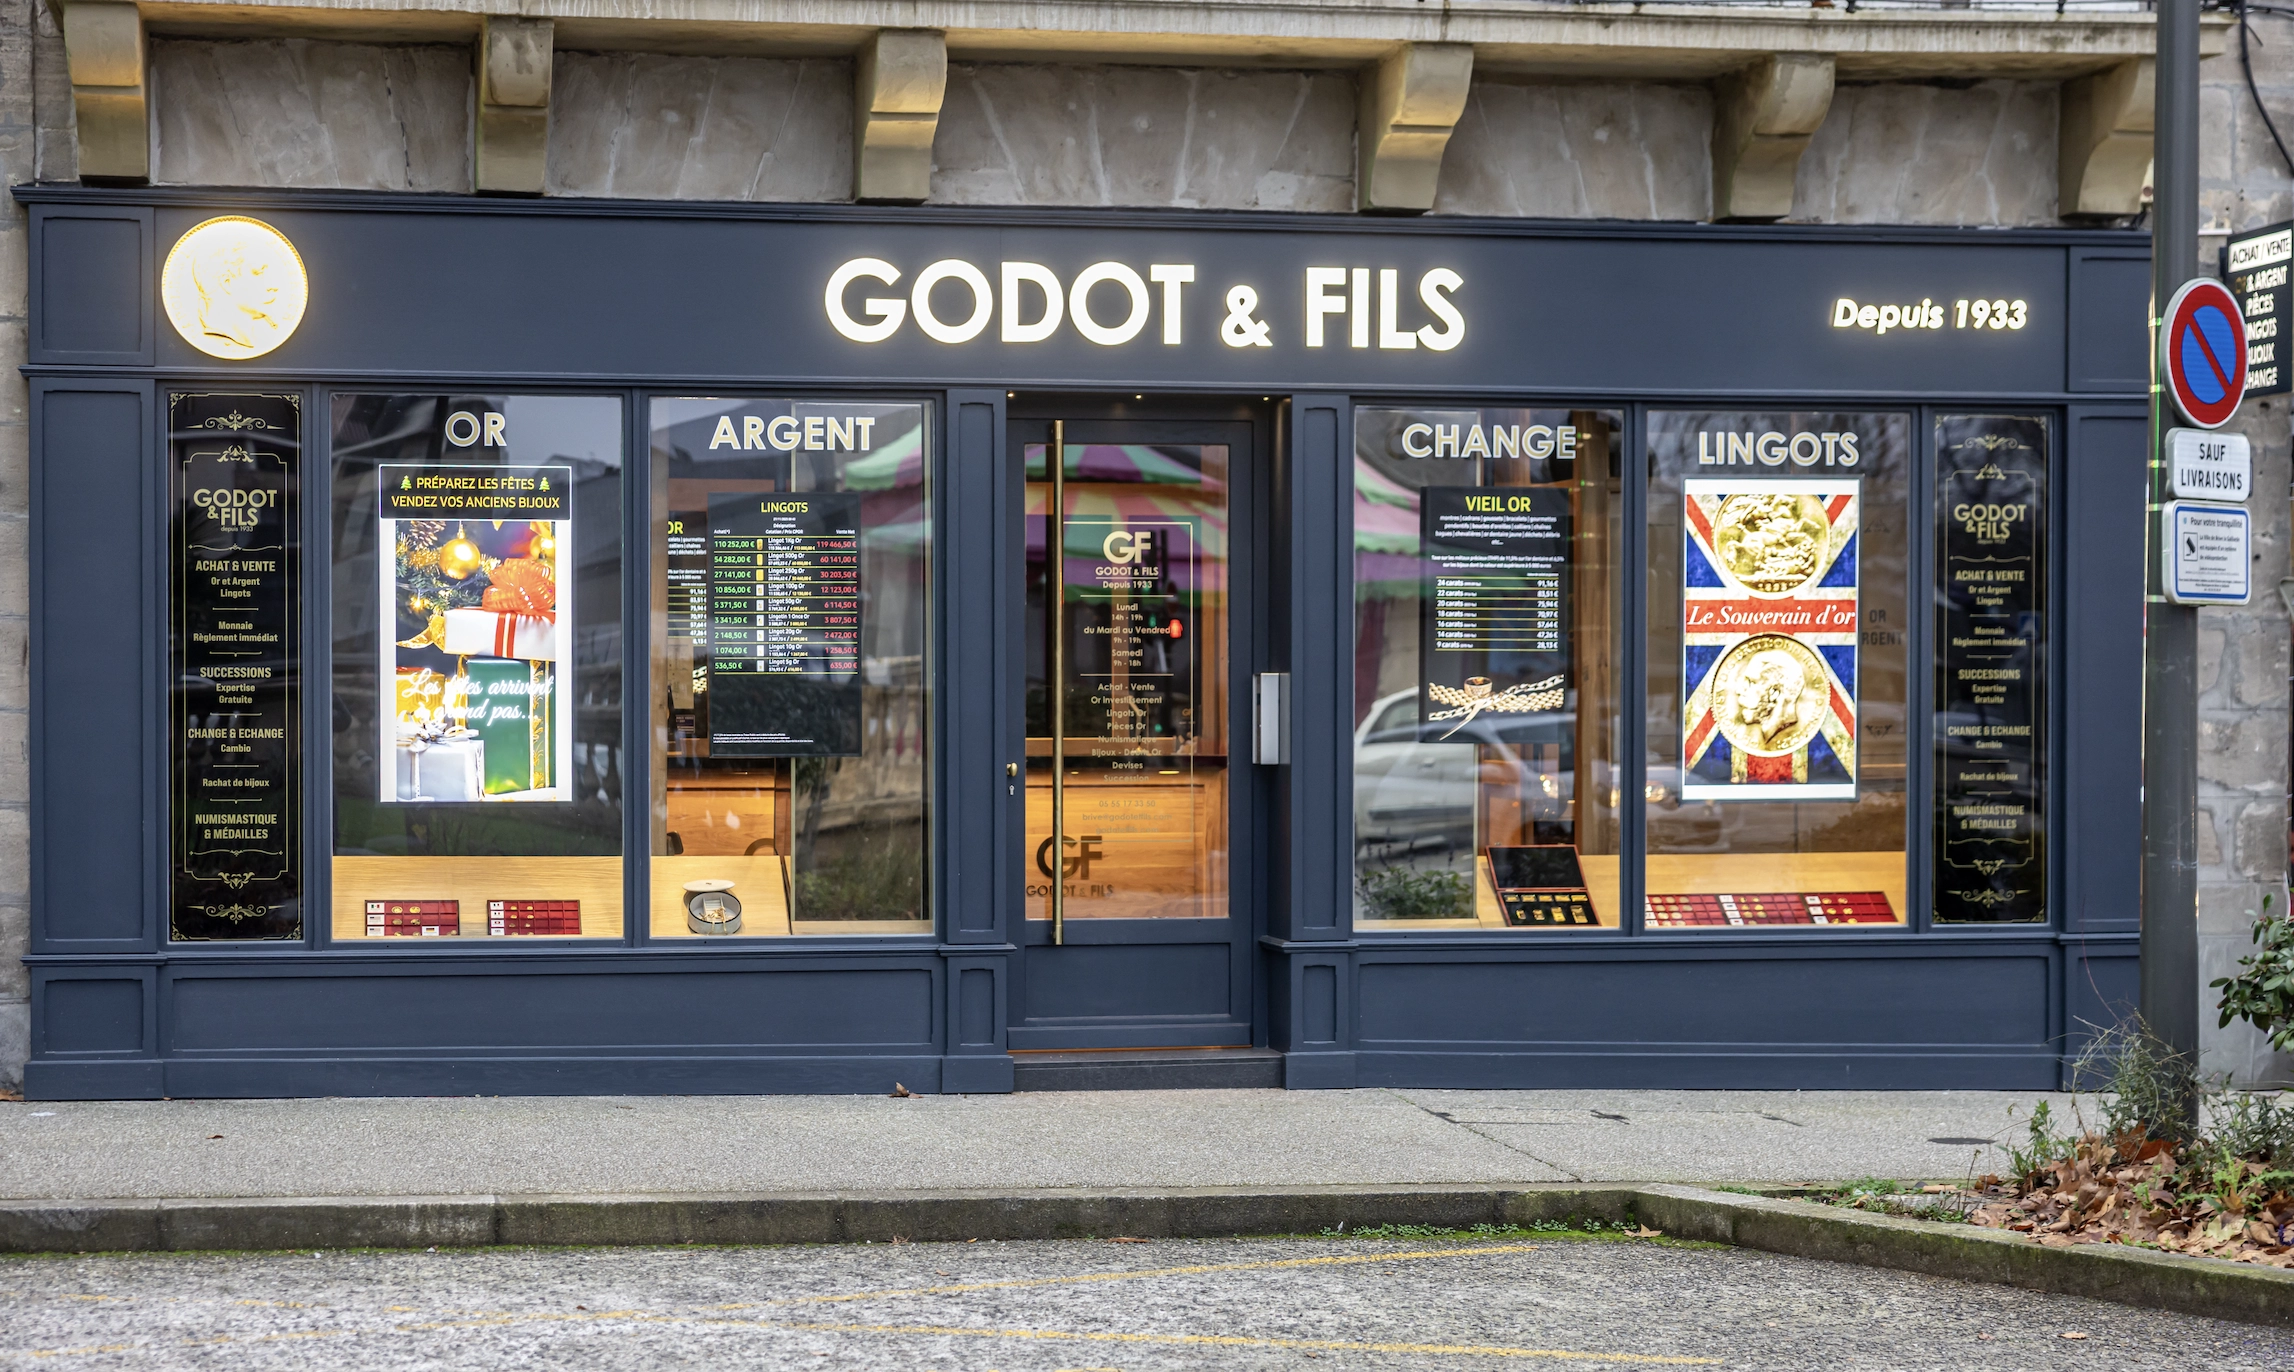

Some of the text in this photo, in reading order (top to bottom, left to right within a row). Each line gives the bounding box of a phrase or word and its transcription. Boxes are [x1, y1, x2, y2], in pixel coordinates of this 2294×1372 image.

[2232, 244, 2259, 264] ACHAT
[2266, 236, 2290, 256] VENTE
[2246, 274, 2254, 293] &
[2254, 265, 2288, 290] ARGENT
[824, 257, 1466, 352] GODOT & FILS
[1833, 298, 2027, 335] Depuis 1933
[2245, 317, 2277, 342] INGOTS
[2248, 342, 2275, 365] IJOUX
[2245, 366, 2278, 390] HANGE
[444, 410, 507, 447] OR
[708, 415, 876, 451] ARGENT
[1401, 422, 1577, 460] CHANGE
[1698, 431, 1860, 467] LINGOTS
[2199, 443, 2226, 462] SAUF
[416, 475, 535, 490] PRÉPAREZ LES FÊTES
[2180, 468, 2243, 490] LIVRAISONS
[193, 488, 278, 508] GODOT
[391, 495, 560, 509] VENDEZ VOS ANCIENS BIJOUX
[760, 502, 808, 514] LINGOTS
[1465, 496, 1531, 512] VIEIL OR
[207, 505, 259, 526] & FILS
[1954, 503, 2027, 522] GODOT
[2190, 516, 2202, 526] Pour
[2203, 518, 2216, 526] votre
[1965, 520, 2010, 539] & FILS
[1103, 530, 1152, 564] GF
[723, 556, 746, 564] 282,00
[830, 556, 852, 564] 141,00
[196, 560, 276, 572] ACHAT & VENTE
[1096, 566, 1159, 576] GODOT & FILS
[723, 571, 746, 579] 141,00
[1955, 570, 1984, 581] ACHAT
[1995, 570, 2025, 581] VENTE
[211, 577, 260, 588] Or et Argent
[1103, 581, 1152, 590] Depuis 1933
[220, 589, 251, 599] Lingots
[714, 586, 722, 594] 10
[723, 586, 746, 594] 856,00
[820, 586, 829, 594] 12
[830, 586, 852, 594] 123,00
[1116, 603, 1138, 611] Lundi
[1687, 604, 1856, 626] Le Souverain d'or
[1869, 610, 1886, 623] OR
[218, 621, 253, 630] Monnaie
[1084, 626, 1094, 634] du
[1097, 626, 1120, 634] Mardi
[193, 633, 278, 643] Règlement immédiat
[1862, 632, 1901, 645] RGENT
[1112, 649, 1143, 657] Samedi
[714, 662, 737, 670] 536,50
[830, 662, 852, 670] 635,00
[200, 667, 272, 678] SUCCESSIONS
[1958, 669, 2020, 680] SUCCESSIONS
[216, 683, 255, 693] Expertise
[402, 668, 442, 702] Les
[488, 675, 554, 696] arrivent
[1098, 683, 1123, 691] Achat
[1130, 683, 1155, 691] Vente
[1972, 684, 2007, 693] Expertise
[219, 695, 253, 704] Gratuite
[1091, 696, 1162, 704] Or Investissement
[1106, 709, 1146, 718] Lingots Or
[1107, 722, 1146, 730] Pièces Or
[1948, 726, 1982, 736] CHANGE
[1991, 726, 2031, 736] ECHANGE
[188, 728, 284, 739] CHANGE & ECHANGE
[1098, 736, 1157, 744] Numismatique
[221, 744, 251, 753] Cambio
[1092, 749, 1116, 757] Bijoux
[203, 778, 270, 788] Rachat de bijoux
[1953, 805, 2025, 816] NUMISMASTIQUE
[195, 814, 277, 825] NUMISMASTIQUE
[1969, 817, 2017, 830] MÉDAILLES
[204, 827, 268, 839] & MÉDAILLES
[1036, 835, 1102, 880] GF
[1090, 884, 1114, 897] FILS
